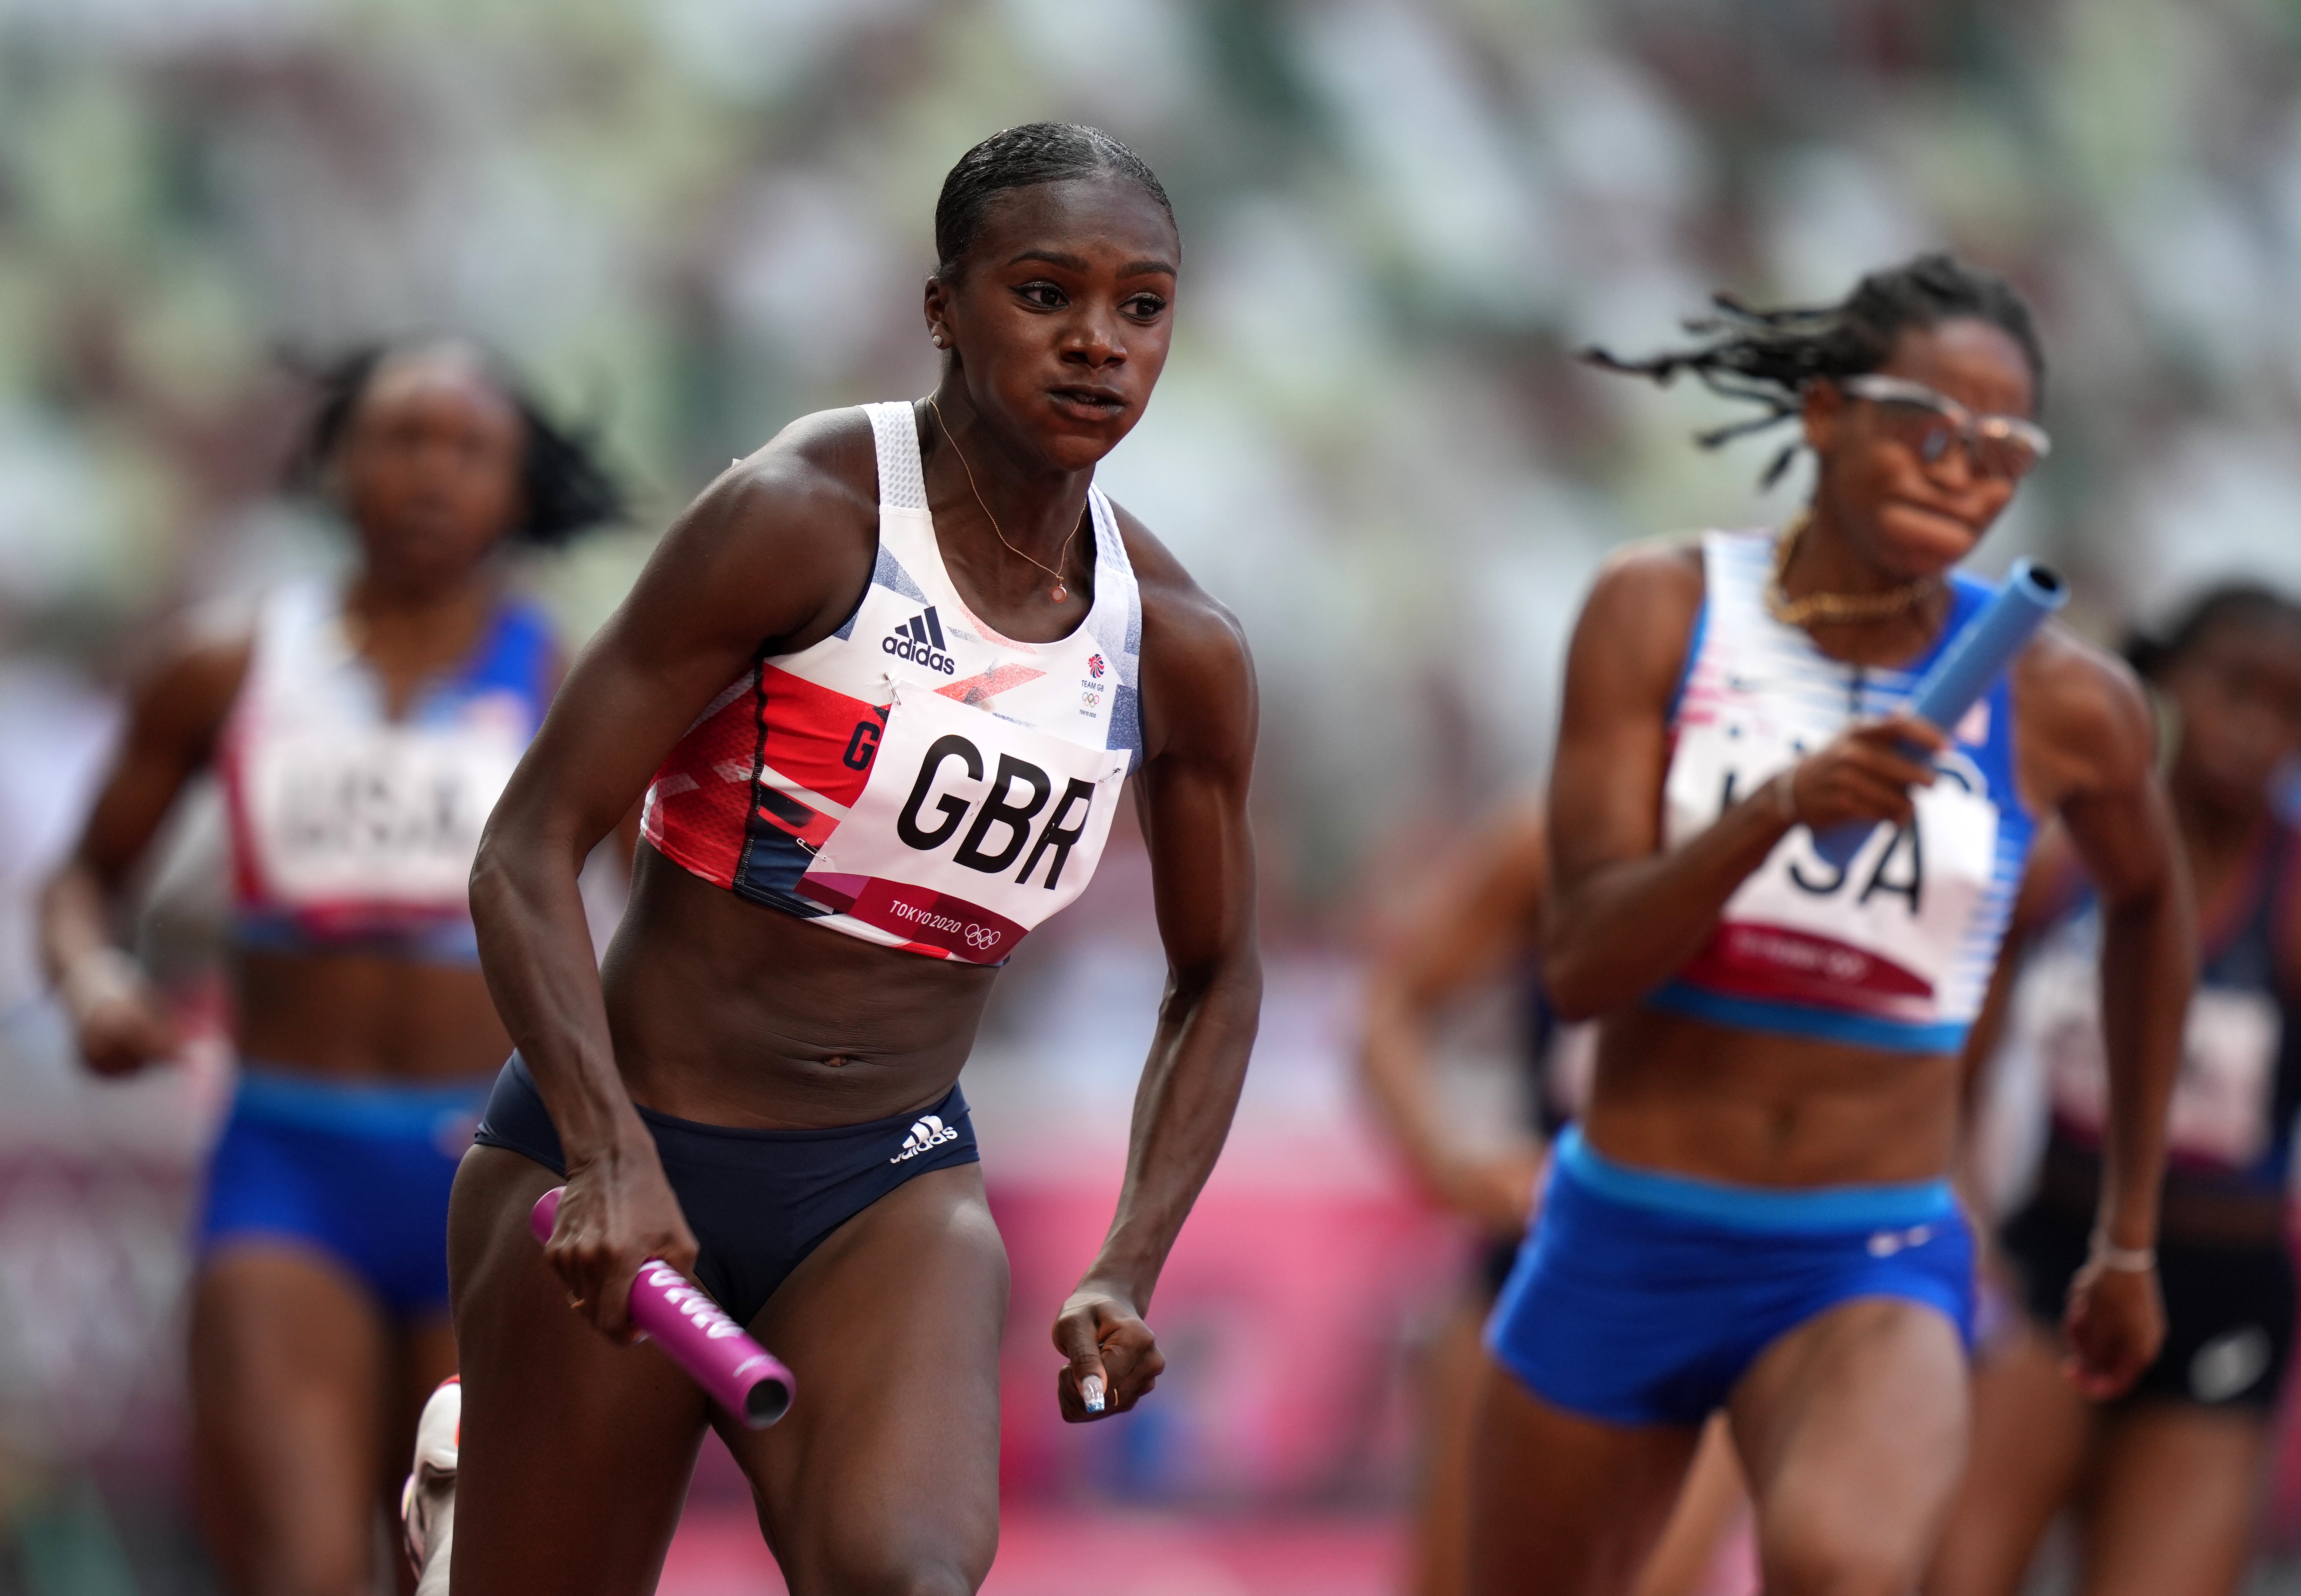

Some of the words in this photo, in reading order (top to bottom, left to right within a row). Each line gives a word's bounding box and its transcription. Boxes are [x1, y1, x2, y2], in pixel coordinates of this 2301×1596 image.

[882, 637, 955, 675] adidas
[1082, 680, 1096, 690] TEAM
[843, 721, 880, 771] G
[897, 734, 1096, 890] GBR
[890, 900, 932, 925] TOKYO
[929, 915, 962, 933] 2020
